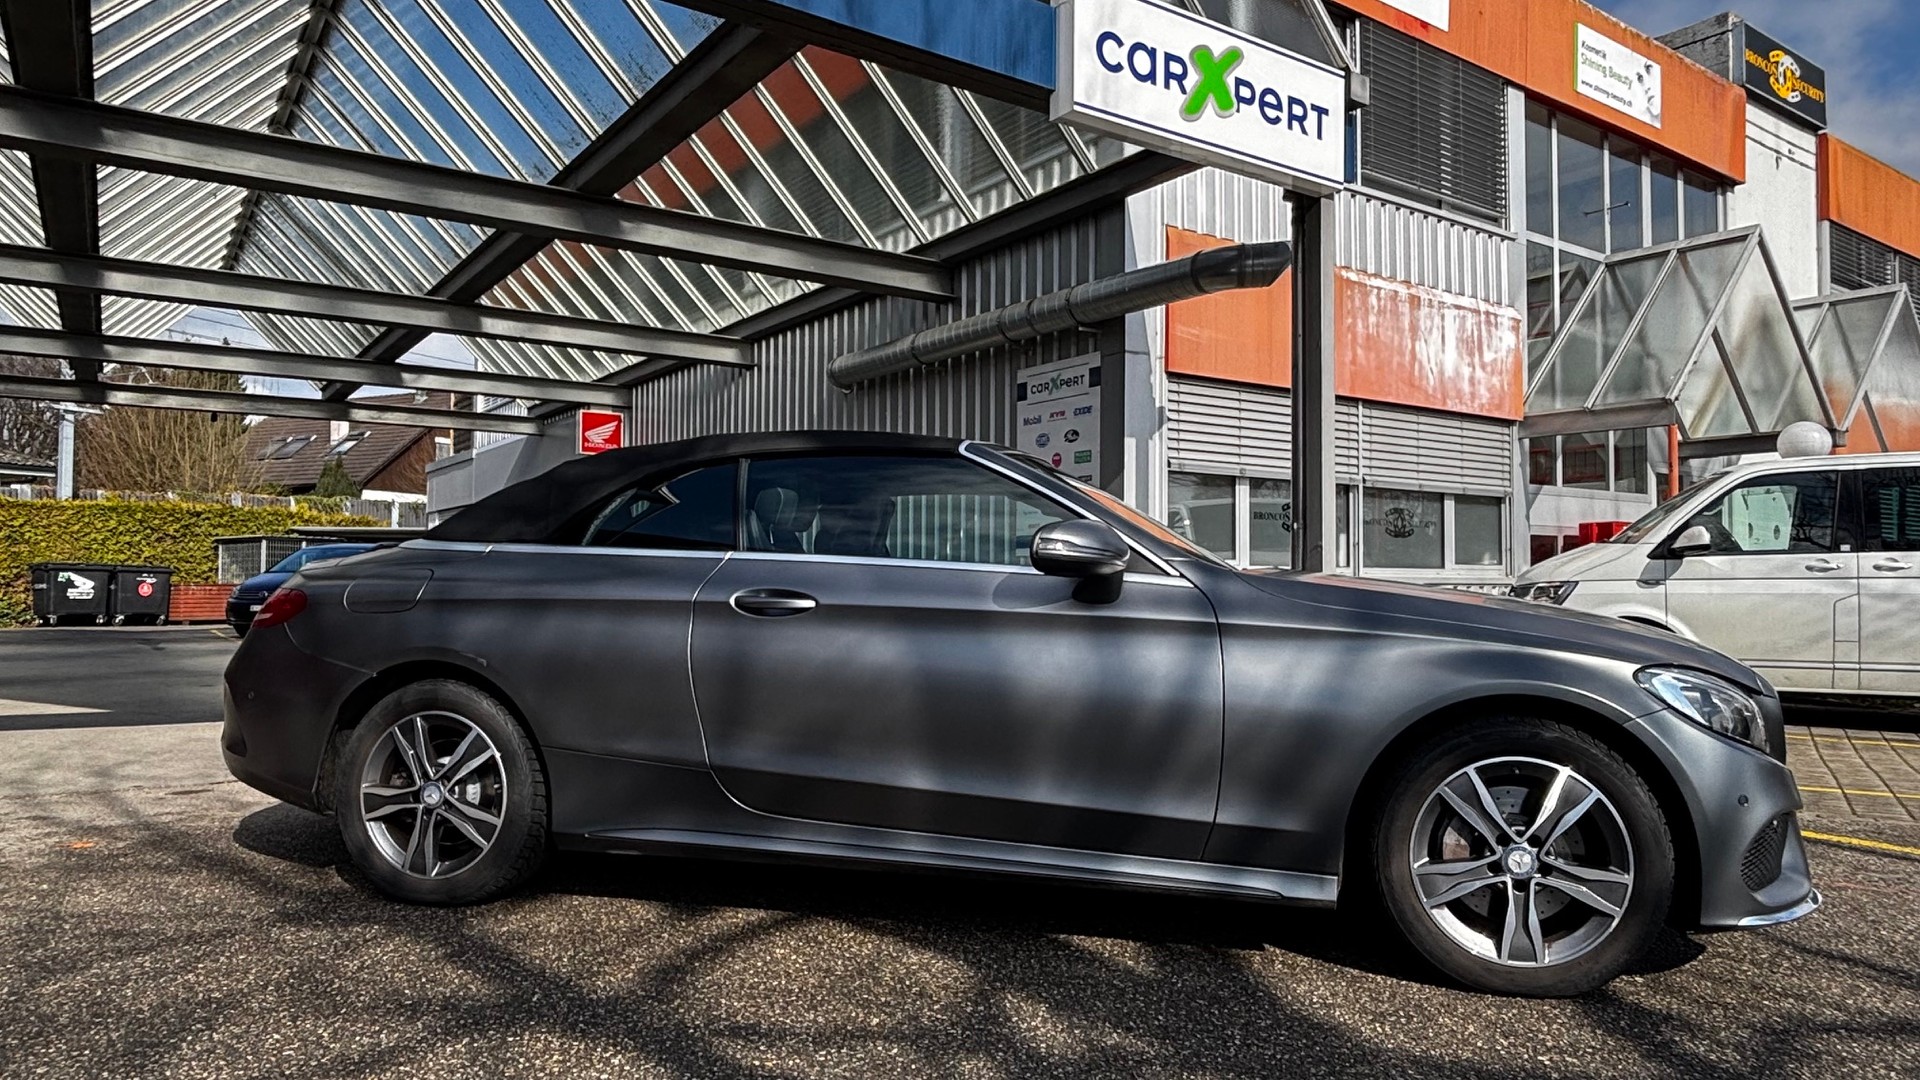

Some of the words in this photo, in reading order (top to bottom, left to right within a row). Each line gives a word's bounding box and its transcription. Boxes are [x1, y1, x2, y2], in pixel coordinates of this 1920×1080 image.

[1581, 52, 1607, 78] Shining
[1608, 66, 1634, 90] Beauty
[1745, 48, 1778, 79] BRONCOS
[1253, 511, 1291, 522] BRONCOS
